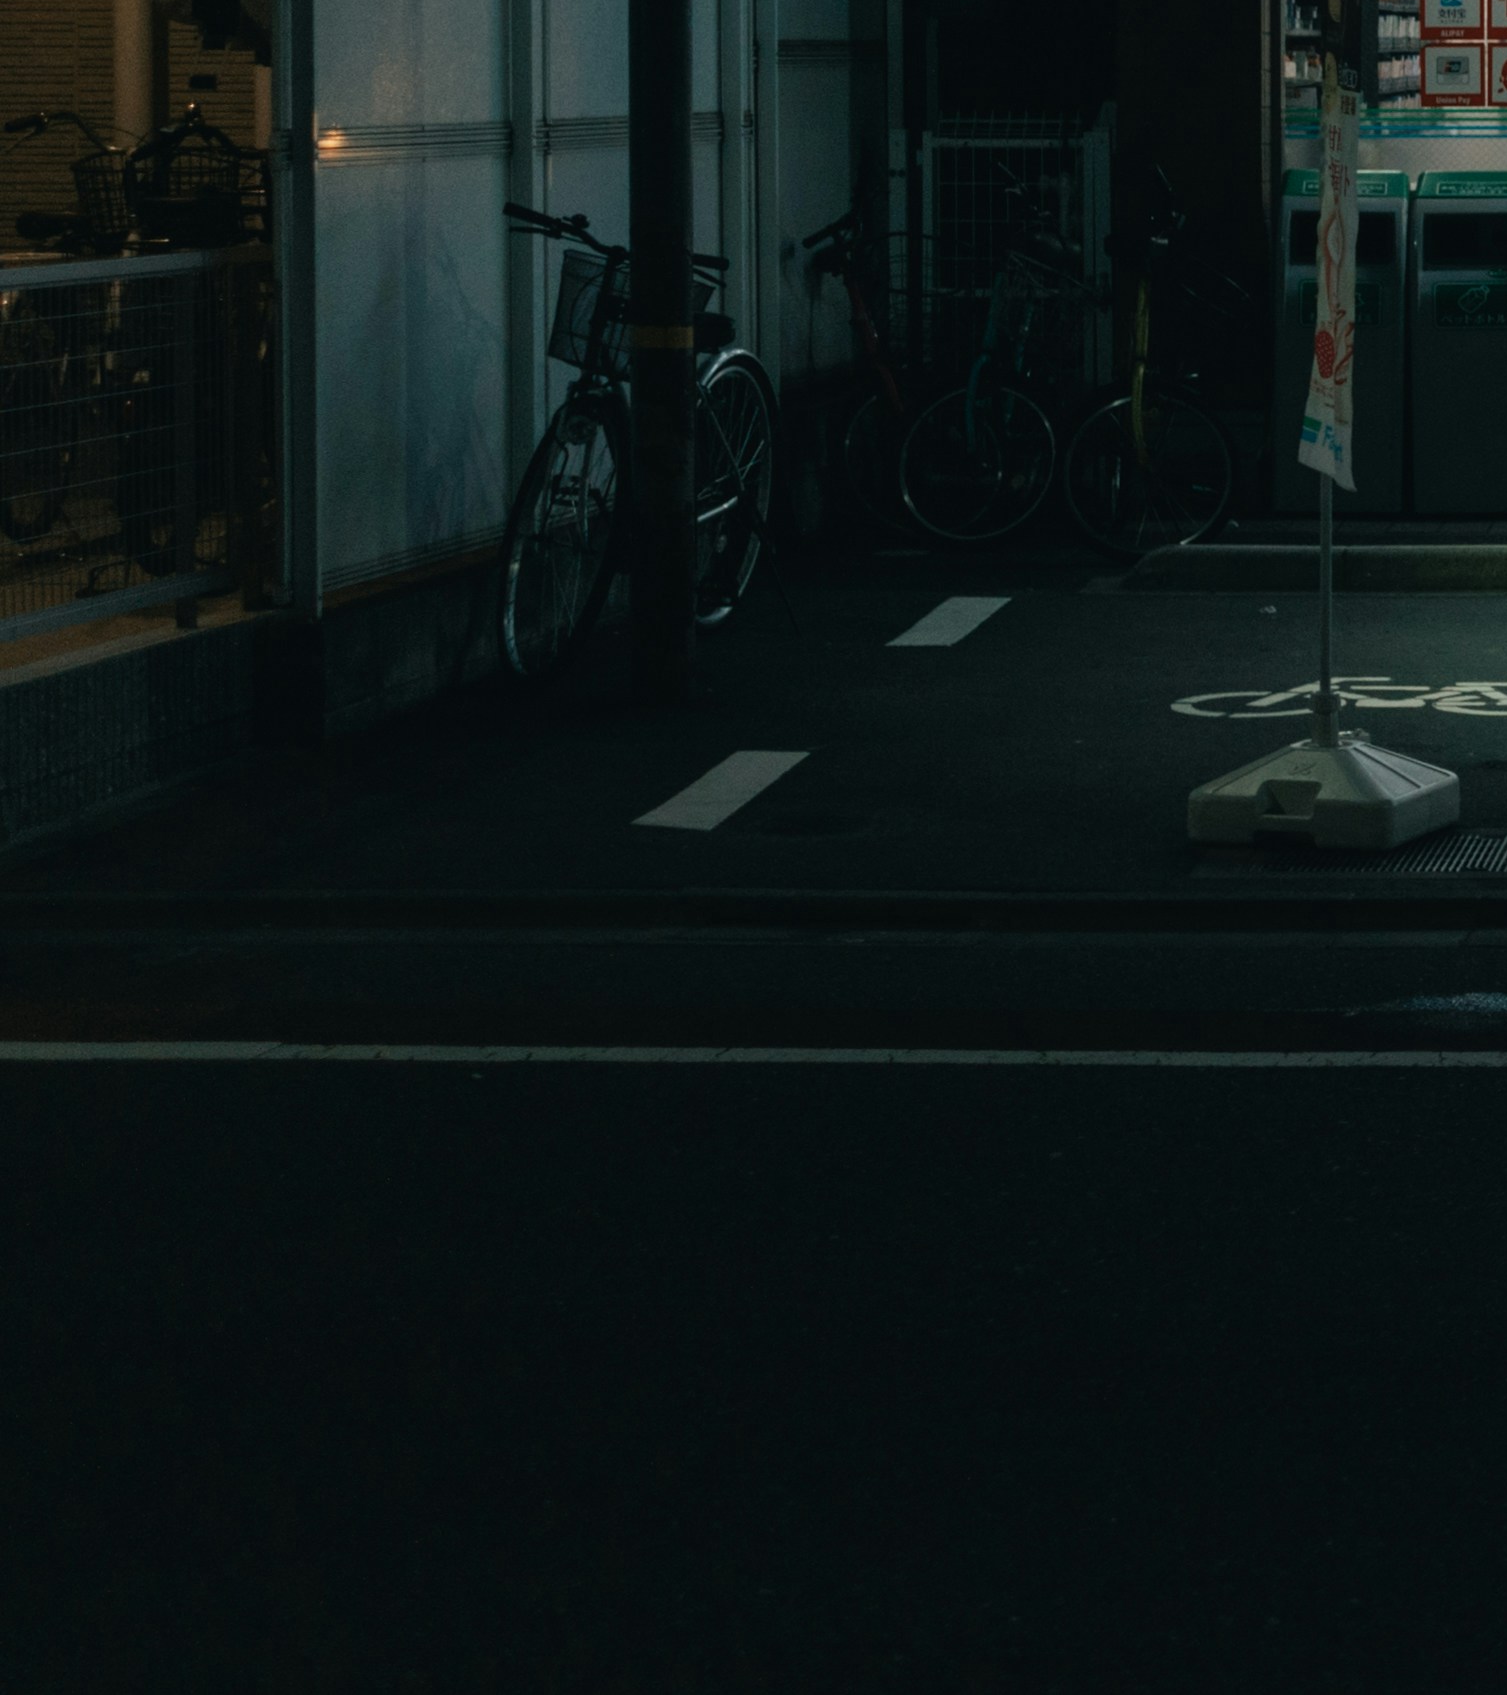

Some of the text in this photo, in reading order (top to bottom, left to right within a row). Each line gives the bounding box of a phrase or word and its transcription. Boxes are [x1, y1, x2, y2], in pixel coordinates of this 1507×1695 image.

[1440, 29, 1465, 38] ALIPAY
[1438, 312, 1507, 326] ペットボトル
